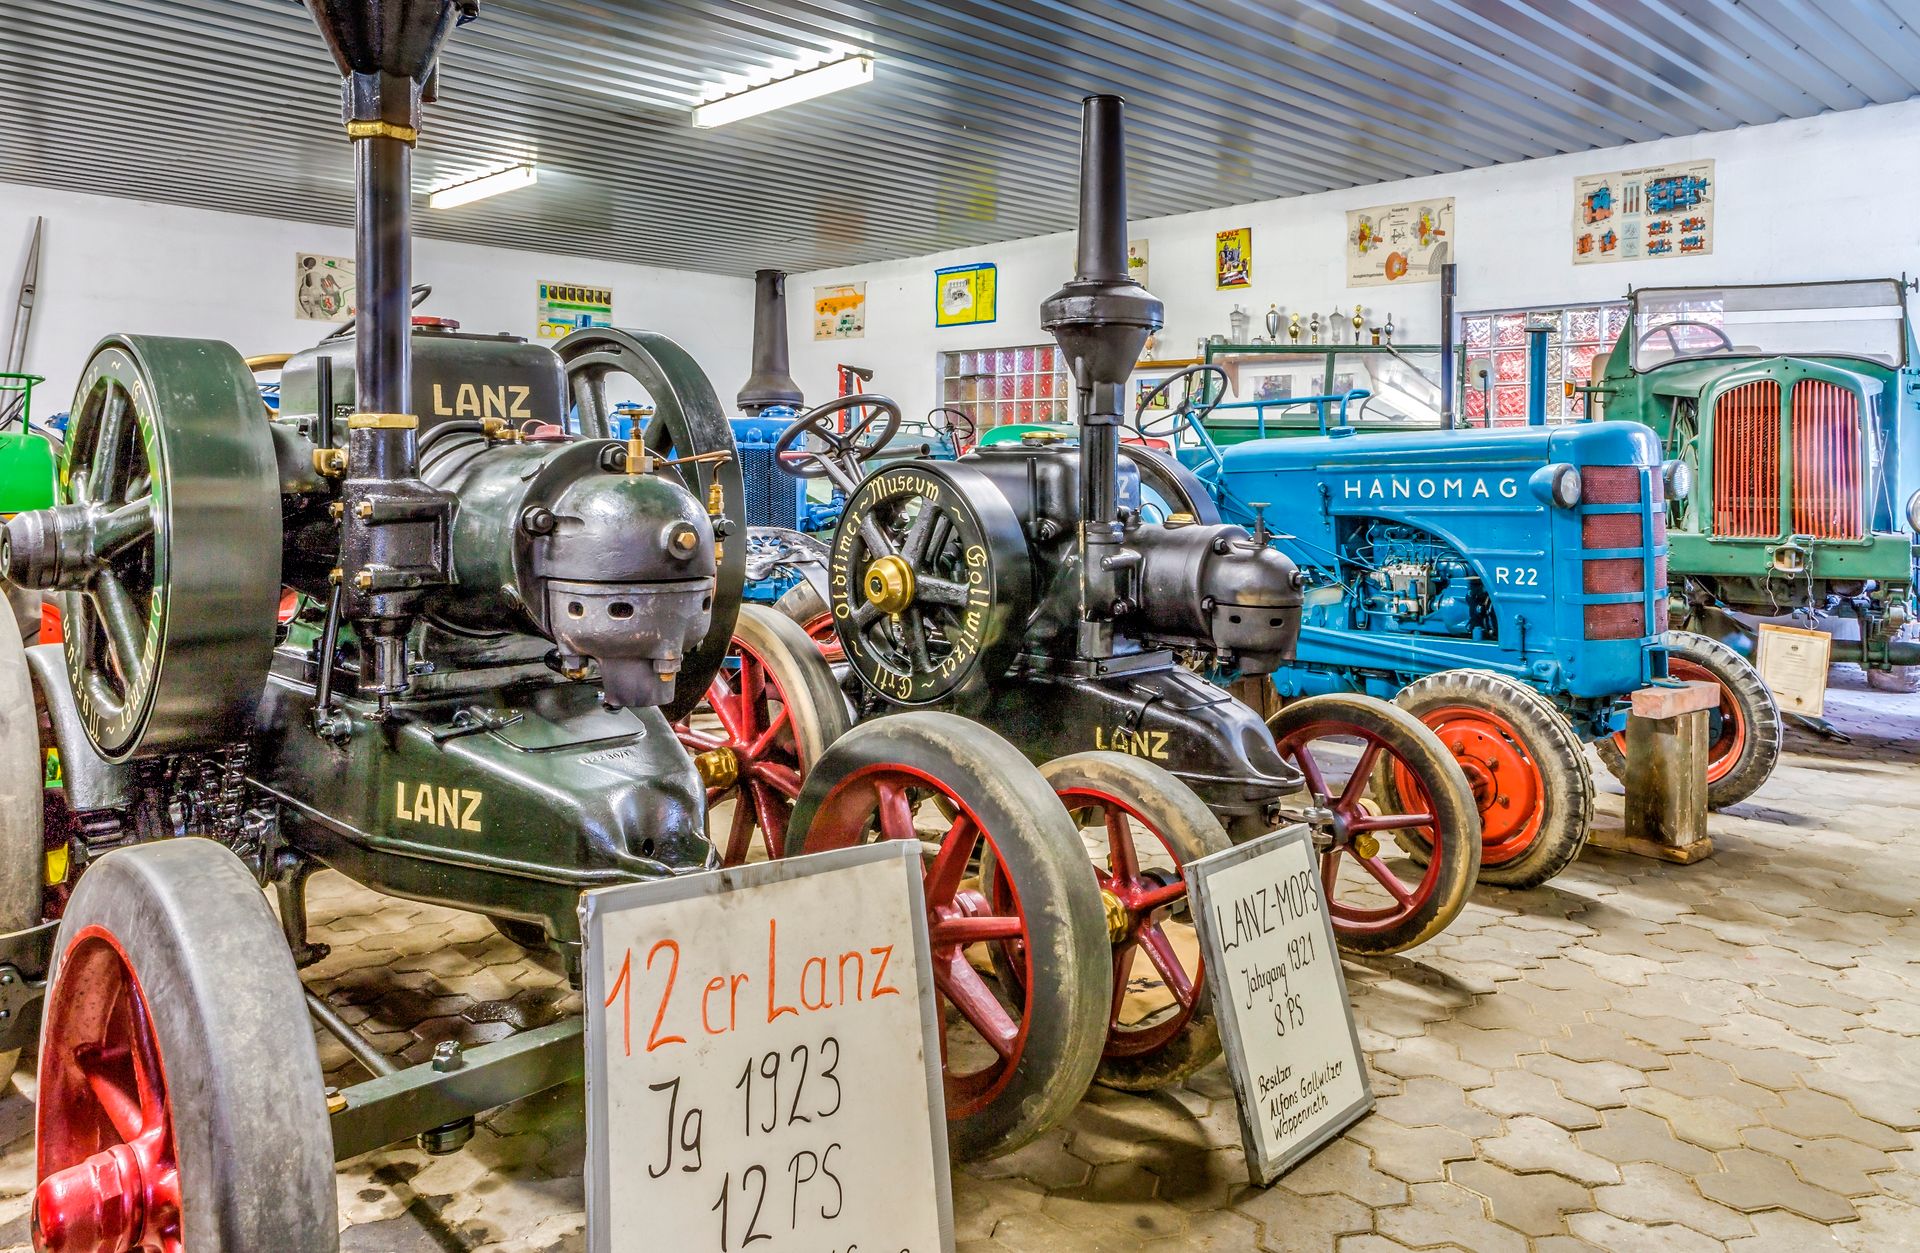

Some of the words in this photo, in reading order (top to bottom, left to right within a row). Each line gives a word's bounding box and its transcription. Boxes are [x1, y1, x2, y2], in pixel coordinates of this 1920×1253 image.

[432, 383, 532, 418] LANZ
[1344, 477, 1518, 499] HANOMAG
[866, 474, 940, 505] Museum
[942, 544, 990, 678] Gollwitzer
[1095, 726, 1169, 760] LANZ
[396, 781, 483, 832] LANZ
[1216, 868, 1320, 953] LANZ-MOPS
[767, 917, 901, 1025] Lanz
[1241, 962, 1289, 1010] Jahrgang
[1286, 932, 1316, 973] 1921
[1274, 1003, 1286, 1037] 8
[1286, 993, 1305, 1030] PS
[1257, 1063, 1293, 1096] Besitzer
[647, 1075, 703, 1179] Jg
[735, 1036, 842, 1137] 1923
[1270, 1090, 1299, 1121] Alfons
[711, 1163, 773, 1253] 12
[787, 1142, 843, 1230] PS
